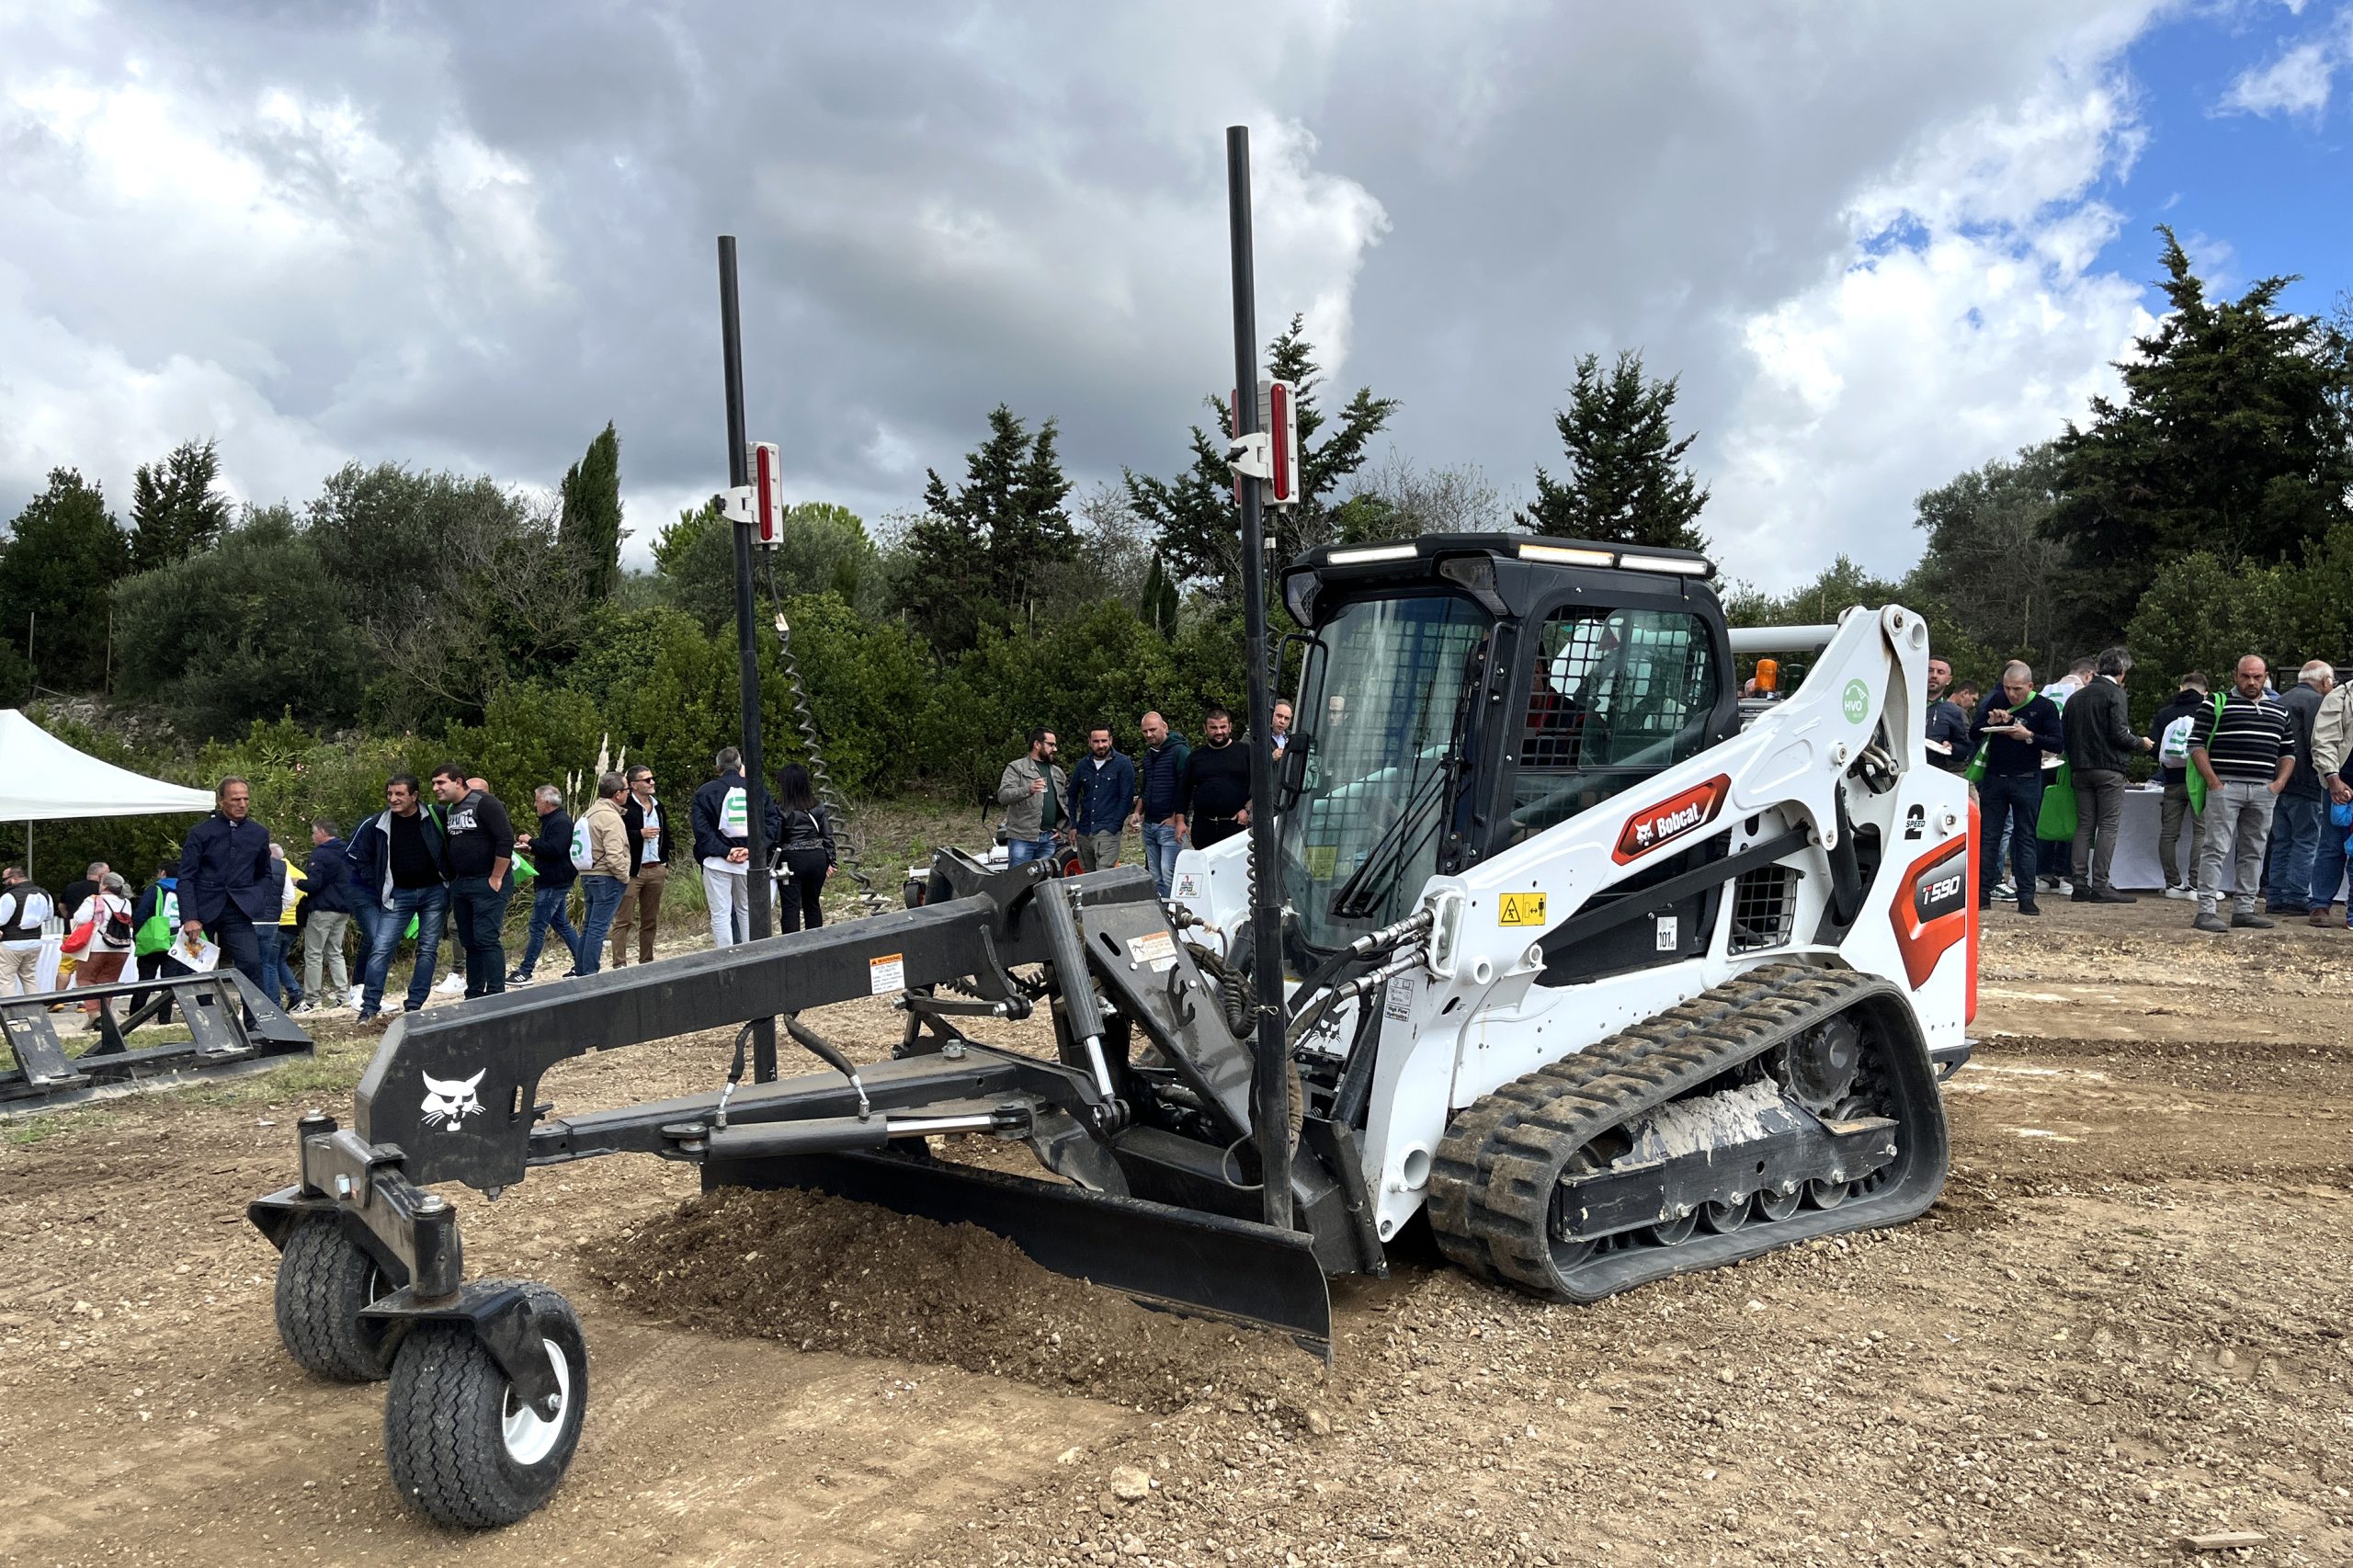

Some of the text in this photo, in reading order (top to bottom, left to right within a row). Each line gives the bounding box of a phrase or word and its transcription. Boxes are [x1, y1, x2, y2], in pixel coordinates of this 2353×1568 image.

[1844, 700, 1862, 712] HVO
[1656, 802, 1699, 838] Bobcat
[1904, 804, 1925, 840] 2
[1905, 820, 1926, 828] SPEED
[1922, 875, 1961, 905] T590
